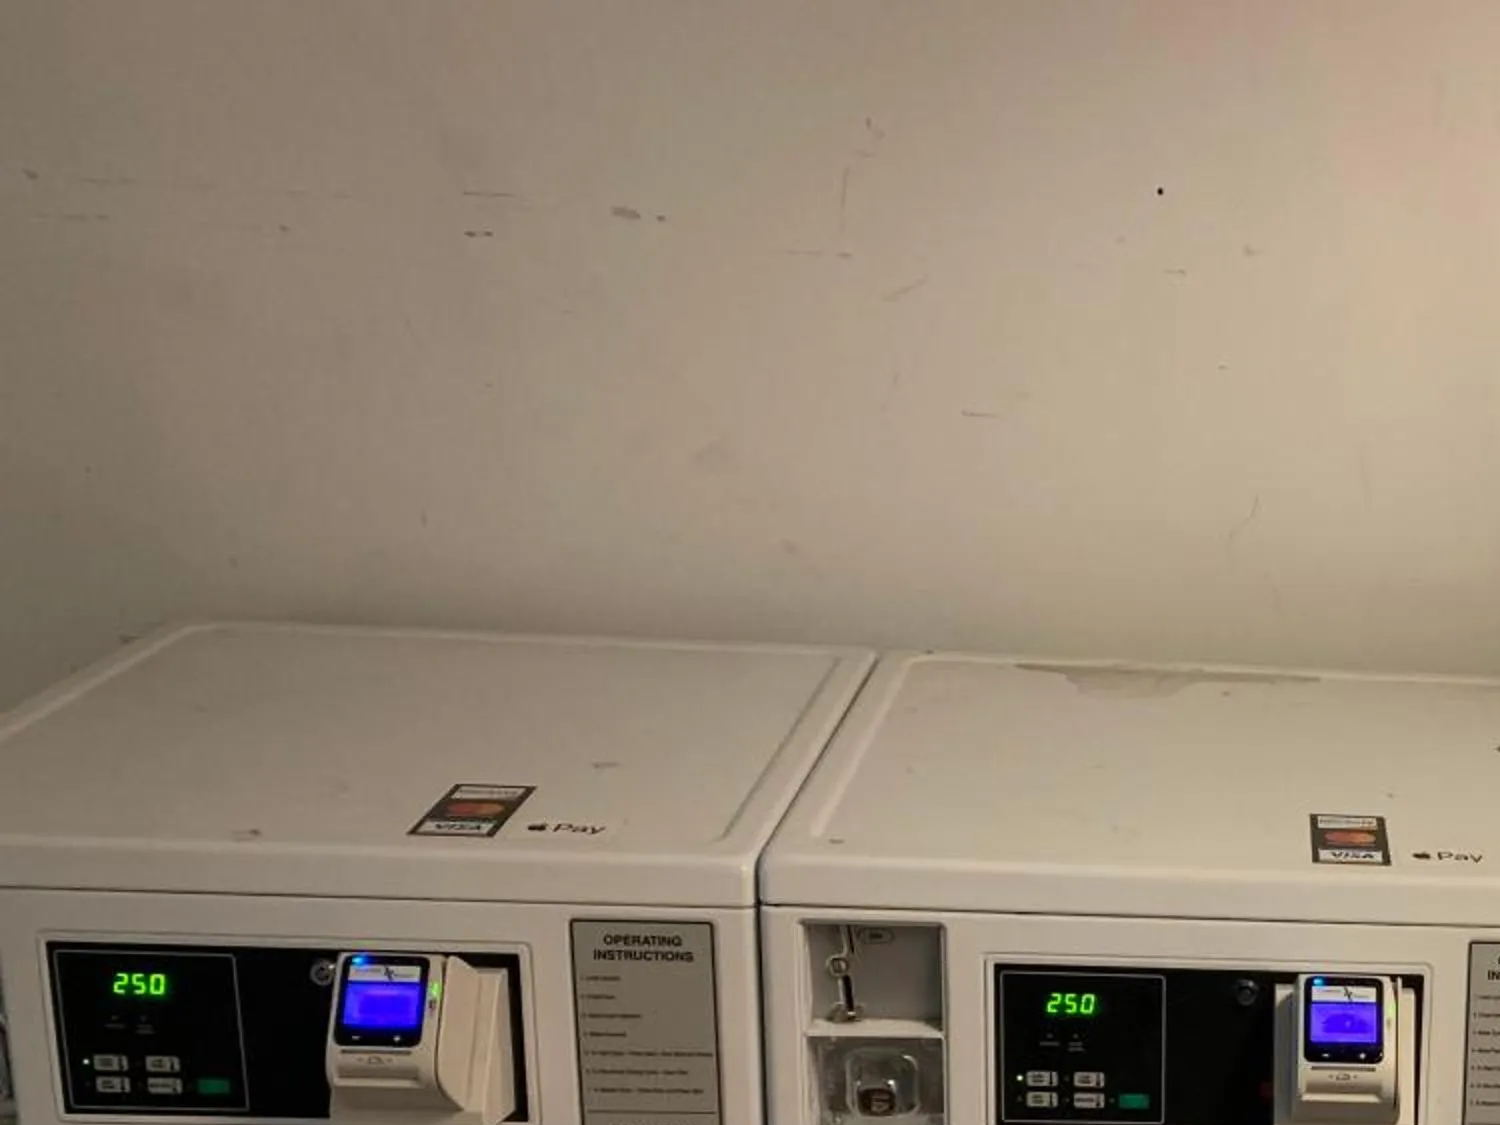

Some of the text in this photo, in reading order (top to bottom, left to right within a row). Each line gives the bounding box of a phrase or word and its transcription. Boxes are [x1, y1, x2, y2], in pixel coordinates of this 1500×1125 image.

[553, 823, 606, 834] Pay
[1330, 851, 1375, 860] VISA
[1438, 851, 1483, 864] Pay
[603, 934, 683, 947] OPERATING
[593, 949, 695, 963] INSTRUCTIONS
